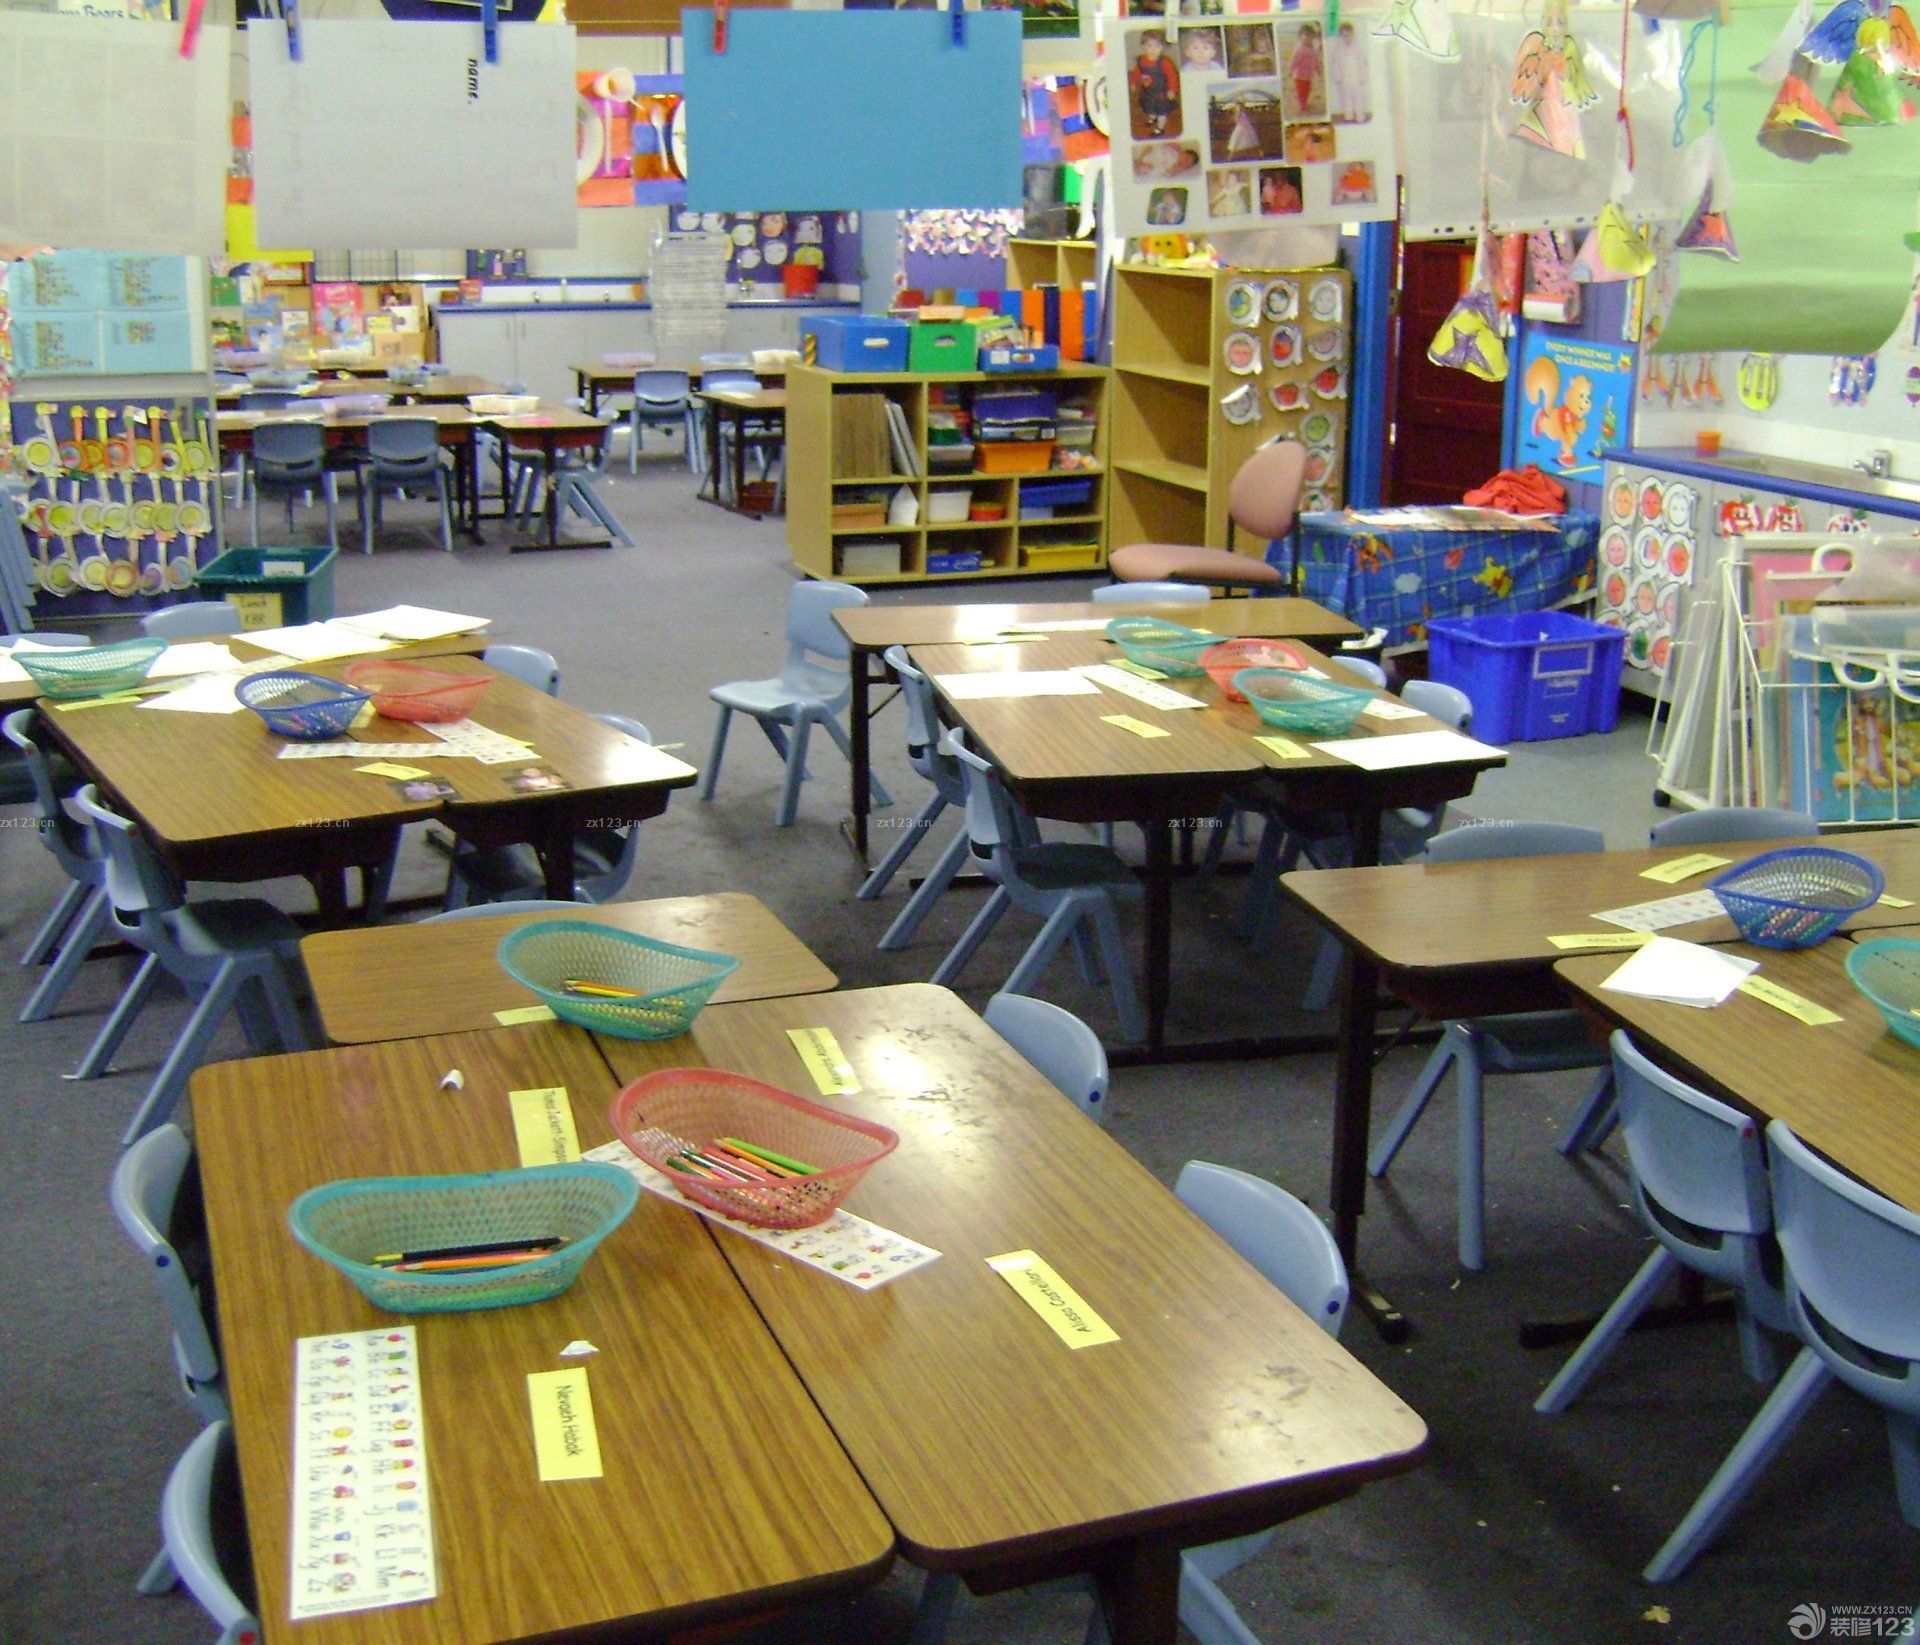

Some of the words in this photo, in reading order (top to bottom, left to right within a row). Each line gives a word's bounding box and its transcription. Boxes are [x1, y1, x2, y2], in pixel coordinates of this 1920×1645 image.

[1546, 341, 1566, 352] EVERY
[1567, 345, 1596, 357] WINNER
[1062, 1307, 1091, 1332] Alissa
